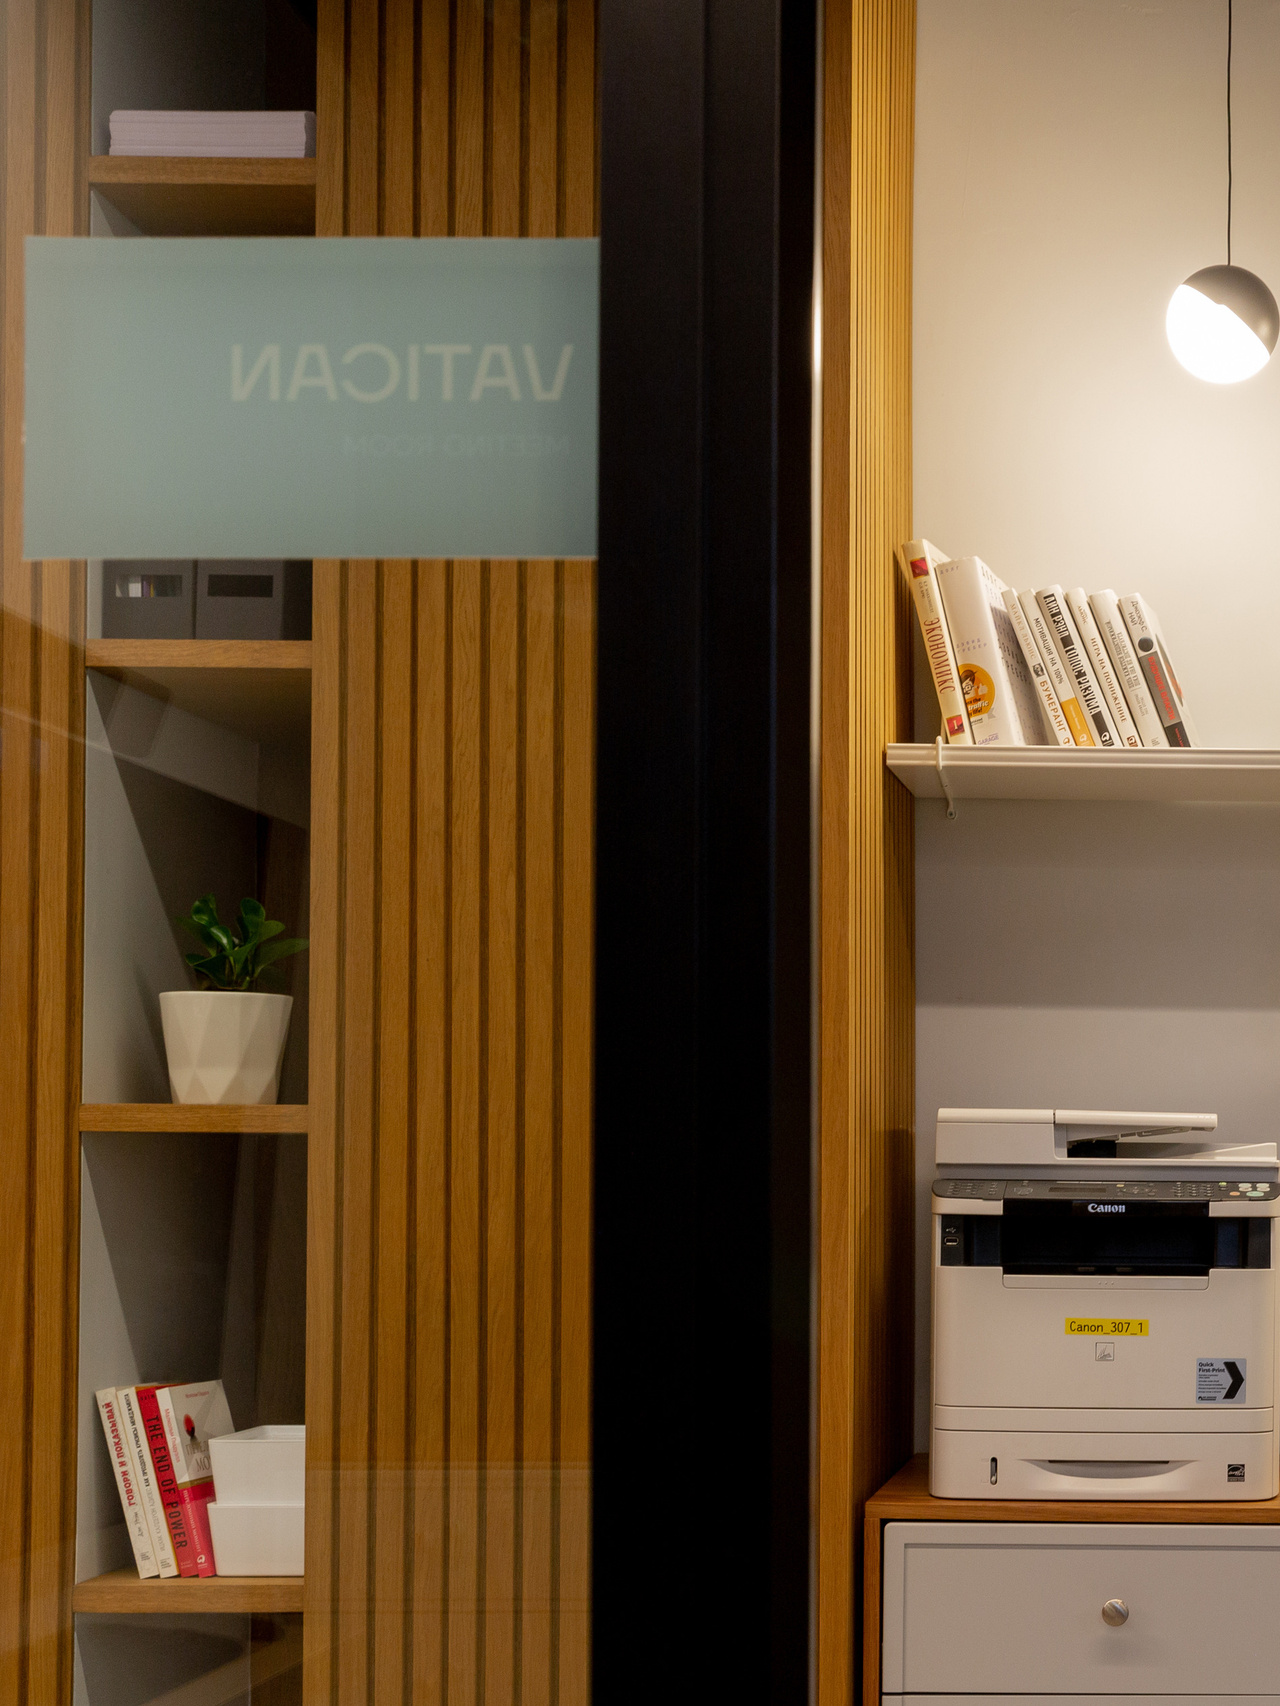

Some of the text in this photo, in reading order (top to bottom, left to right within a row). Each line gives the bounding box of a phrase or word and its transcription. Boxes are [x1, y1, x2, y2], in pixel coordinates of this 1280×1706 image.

[1127, 611, 1137, 626] НАЙ
[1130, 600, 1144, 625] Джозеф
[924, 618, 954, 693] ЭКОНОМИКС
[1032, 618, 1064, 684] МОТИВАЦИЯ НА 100%
[1064, 645, 1100, 714] ГОЛОС РАЗУМА
[1090, 637, 1126, 722] ИГРА НА ПОНИЖЕНИЕ
[1147, 656, 1175, 720] БУДУЩЕЕ ВЛАСТИ
[968, 700, 989, 711] traffic
[1039, 680, 1066, 733] БУМЕРАНГ
[1087, 1203, 1125, 1213] Canon
[1070, 1321, 1143, 1335] Canon_307_1
[102, 1402, 123, 1457] ПОКАЗЫВАЙ
[123, 1394, 135, 1425] МЕНЕДЖМЕНТА
[136, 1449, 147, 1476] ПРЕОДОЛЕТЬ
[146, 1415, 186, 1548] THE END OF POWER
[120, 1470, 135, 1505] ГОВОРИ
